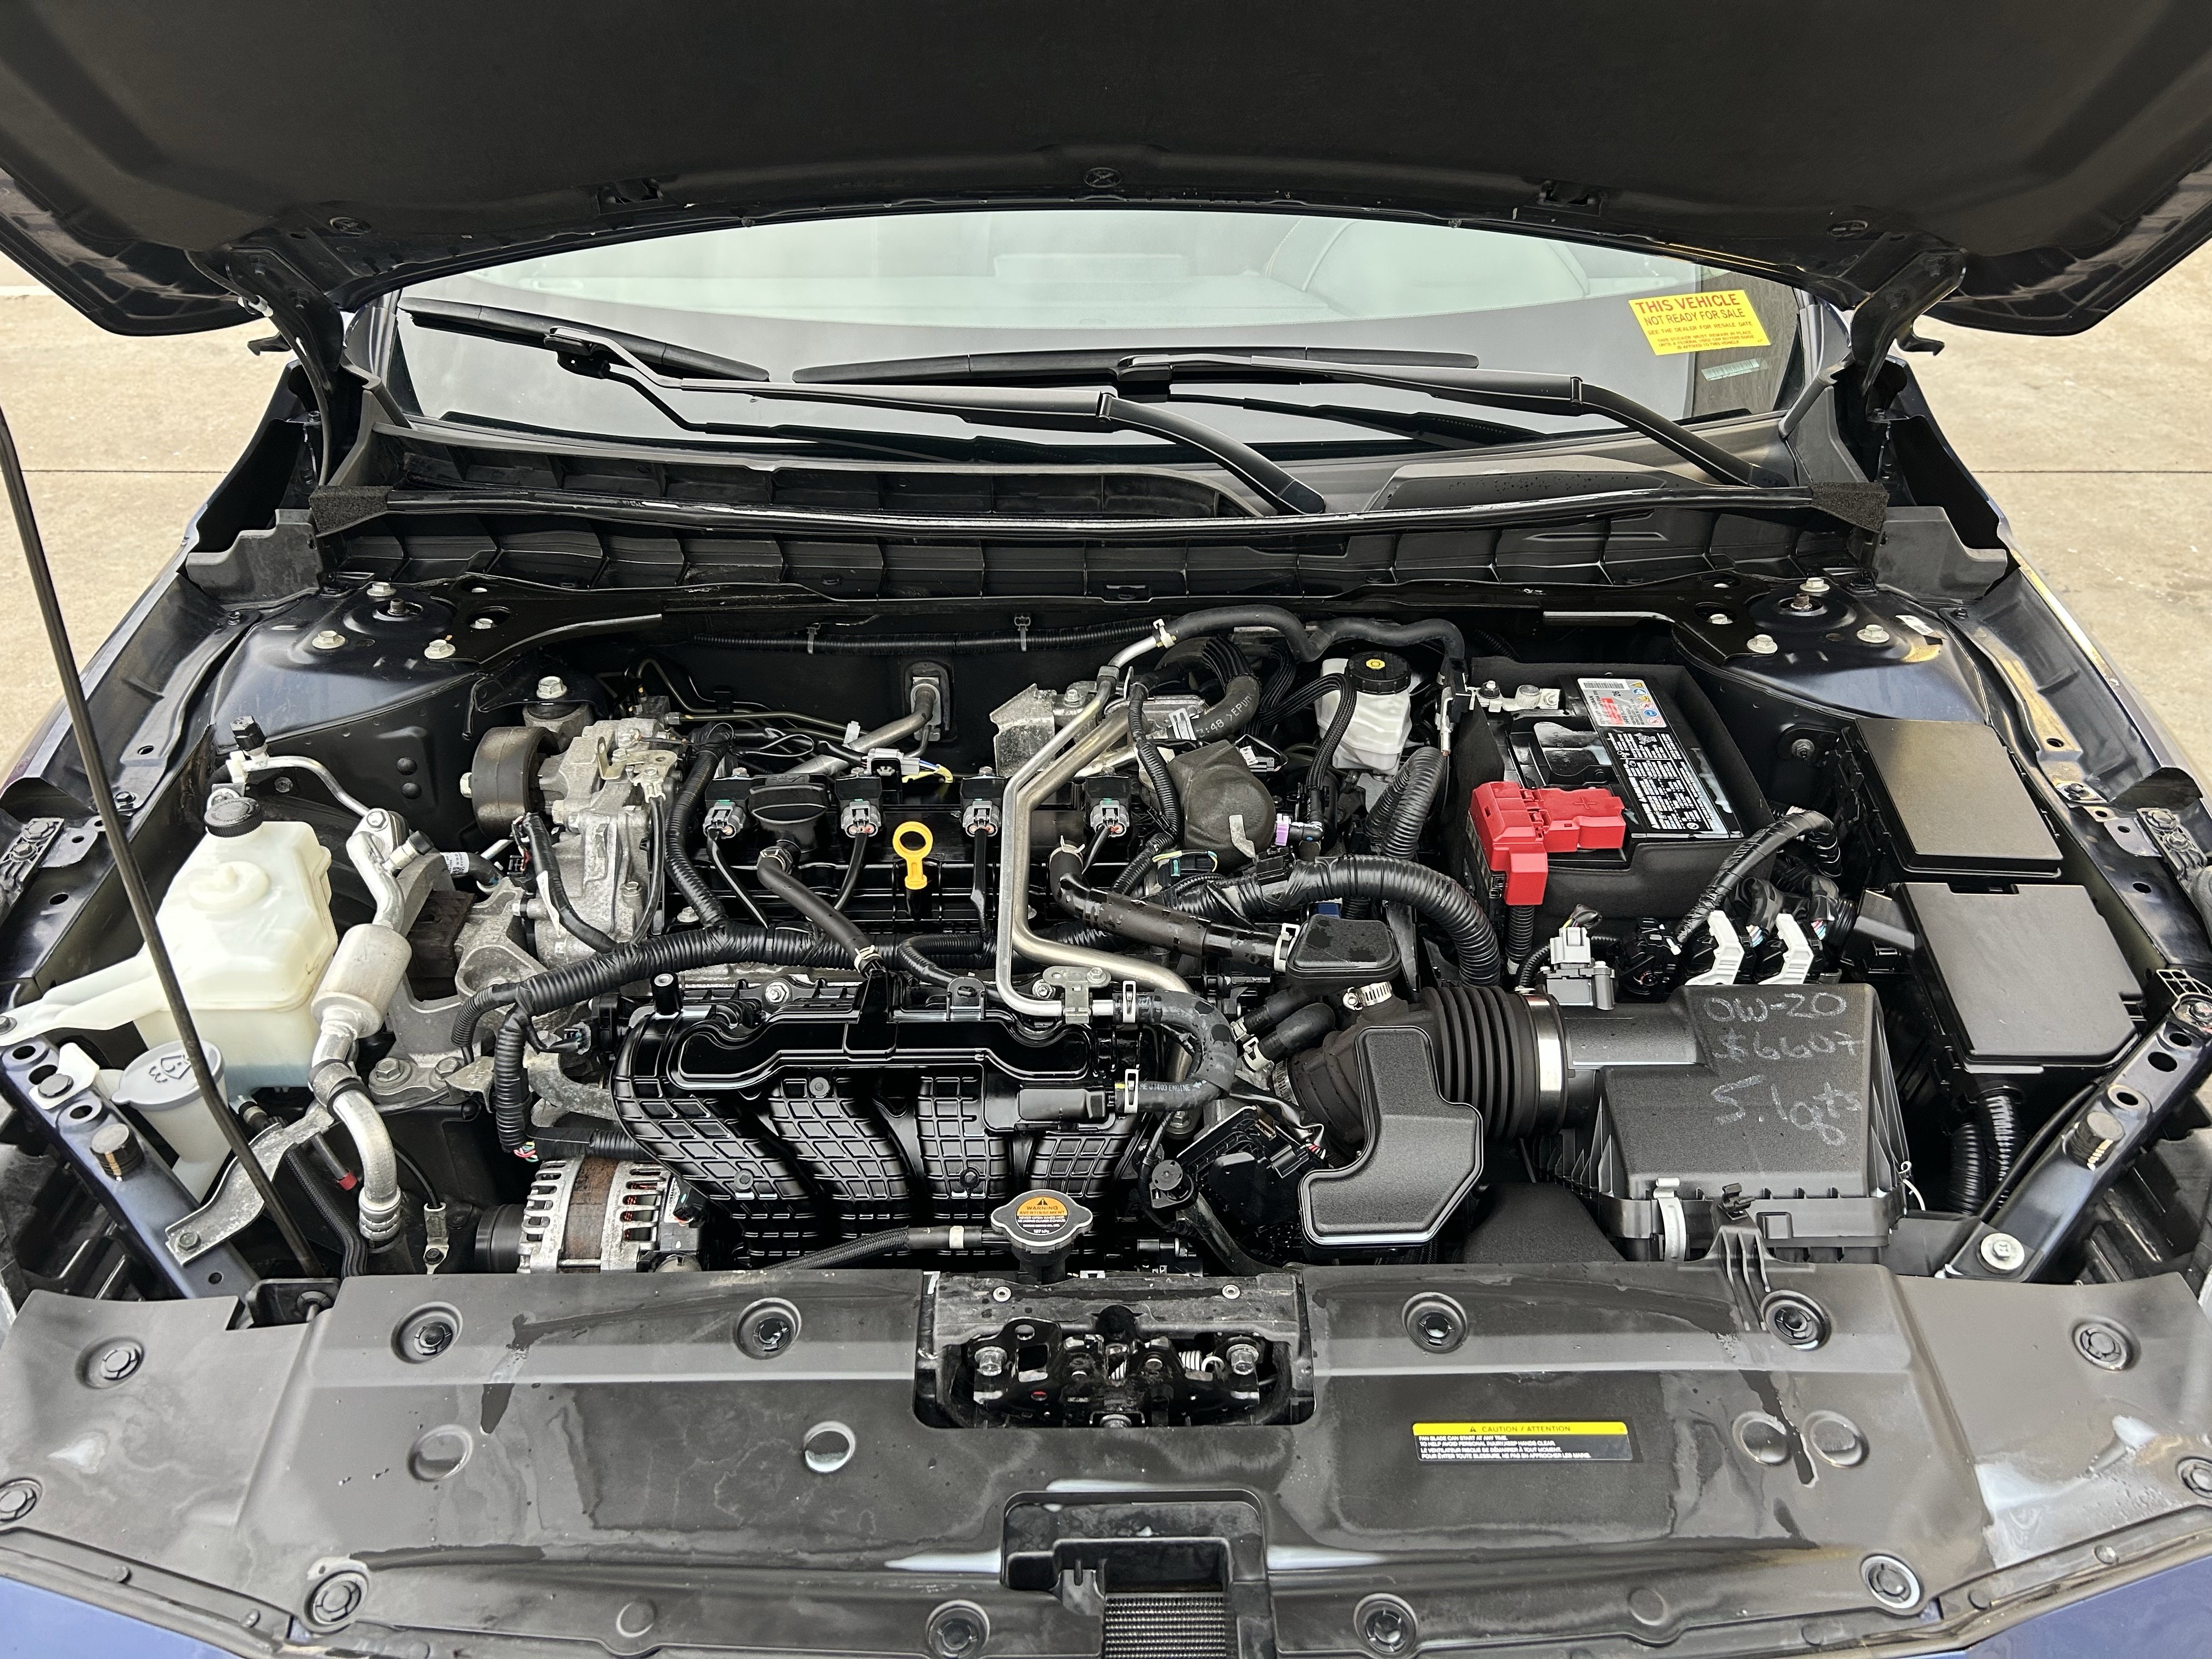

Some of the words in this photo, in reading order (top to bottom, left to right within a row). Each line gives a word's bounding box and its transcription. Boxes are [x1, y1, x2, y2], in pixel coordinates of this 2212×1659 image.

[1635, 300, 1673, 313] THIS
[1674, 294, 1740, 309] VEHICLE
[1644, 315, 1664, 326] NOT
[1666, 312, 1698, 324] READY
[1700, 310, 1720, 319] FOR
[1720, 308, 1746, 318] SALE
[1169, 1084, 1191, 1092] ENGINE
